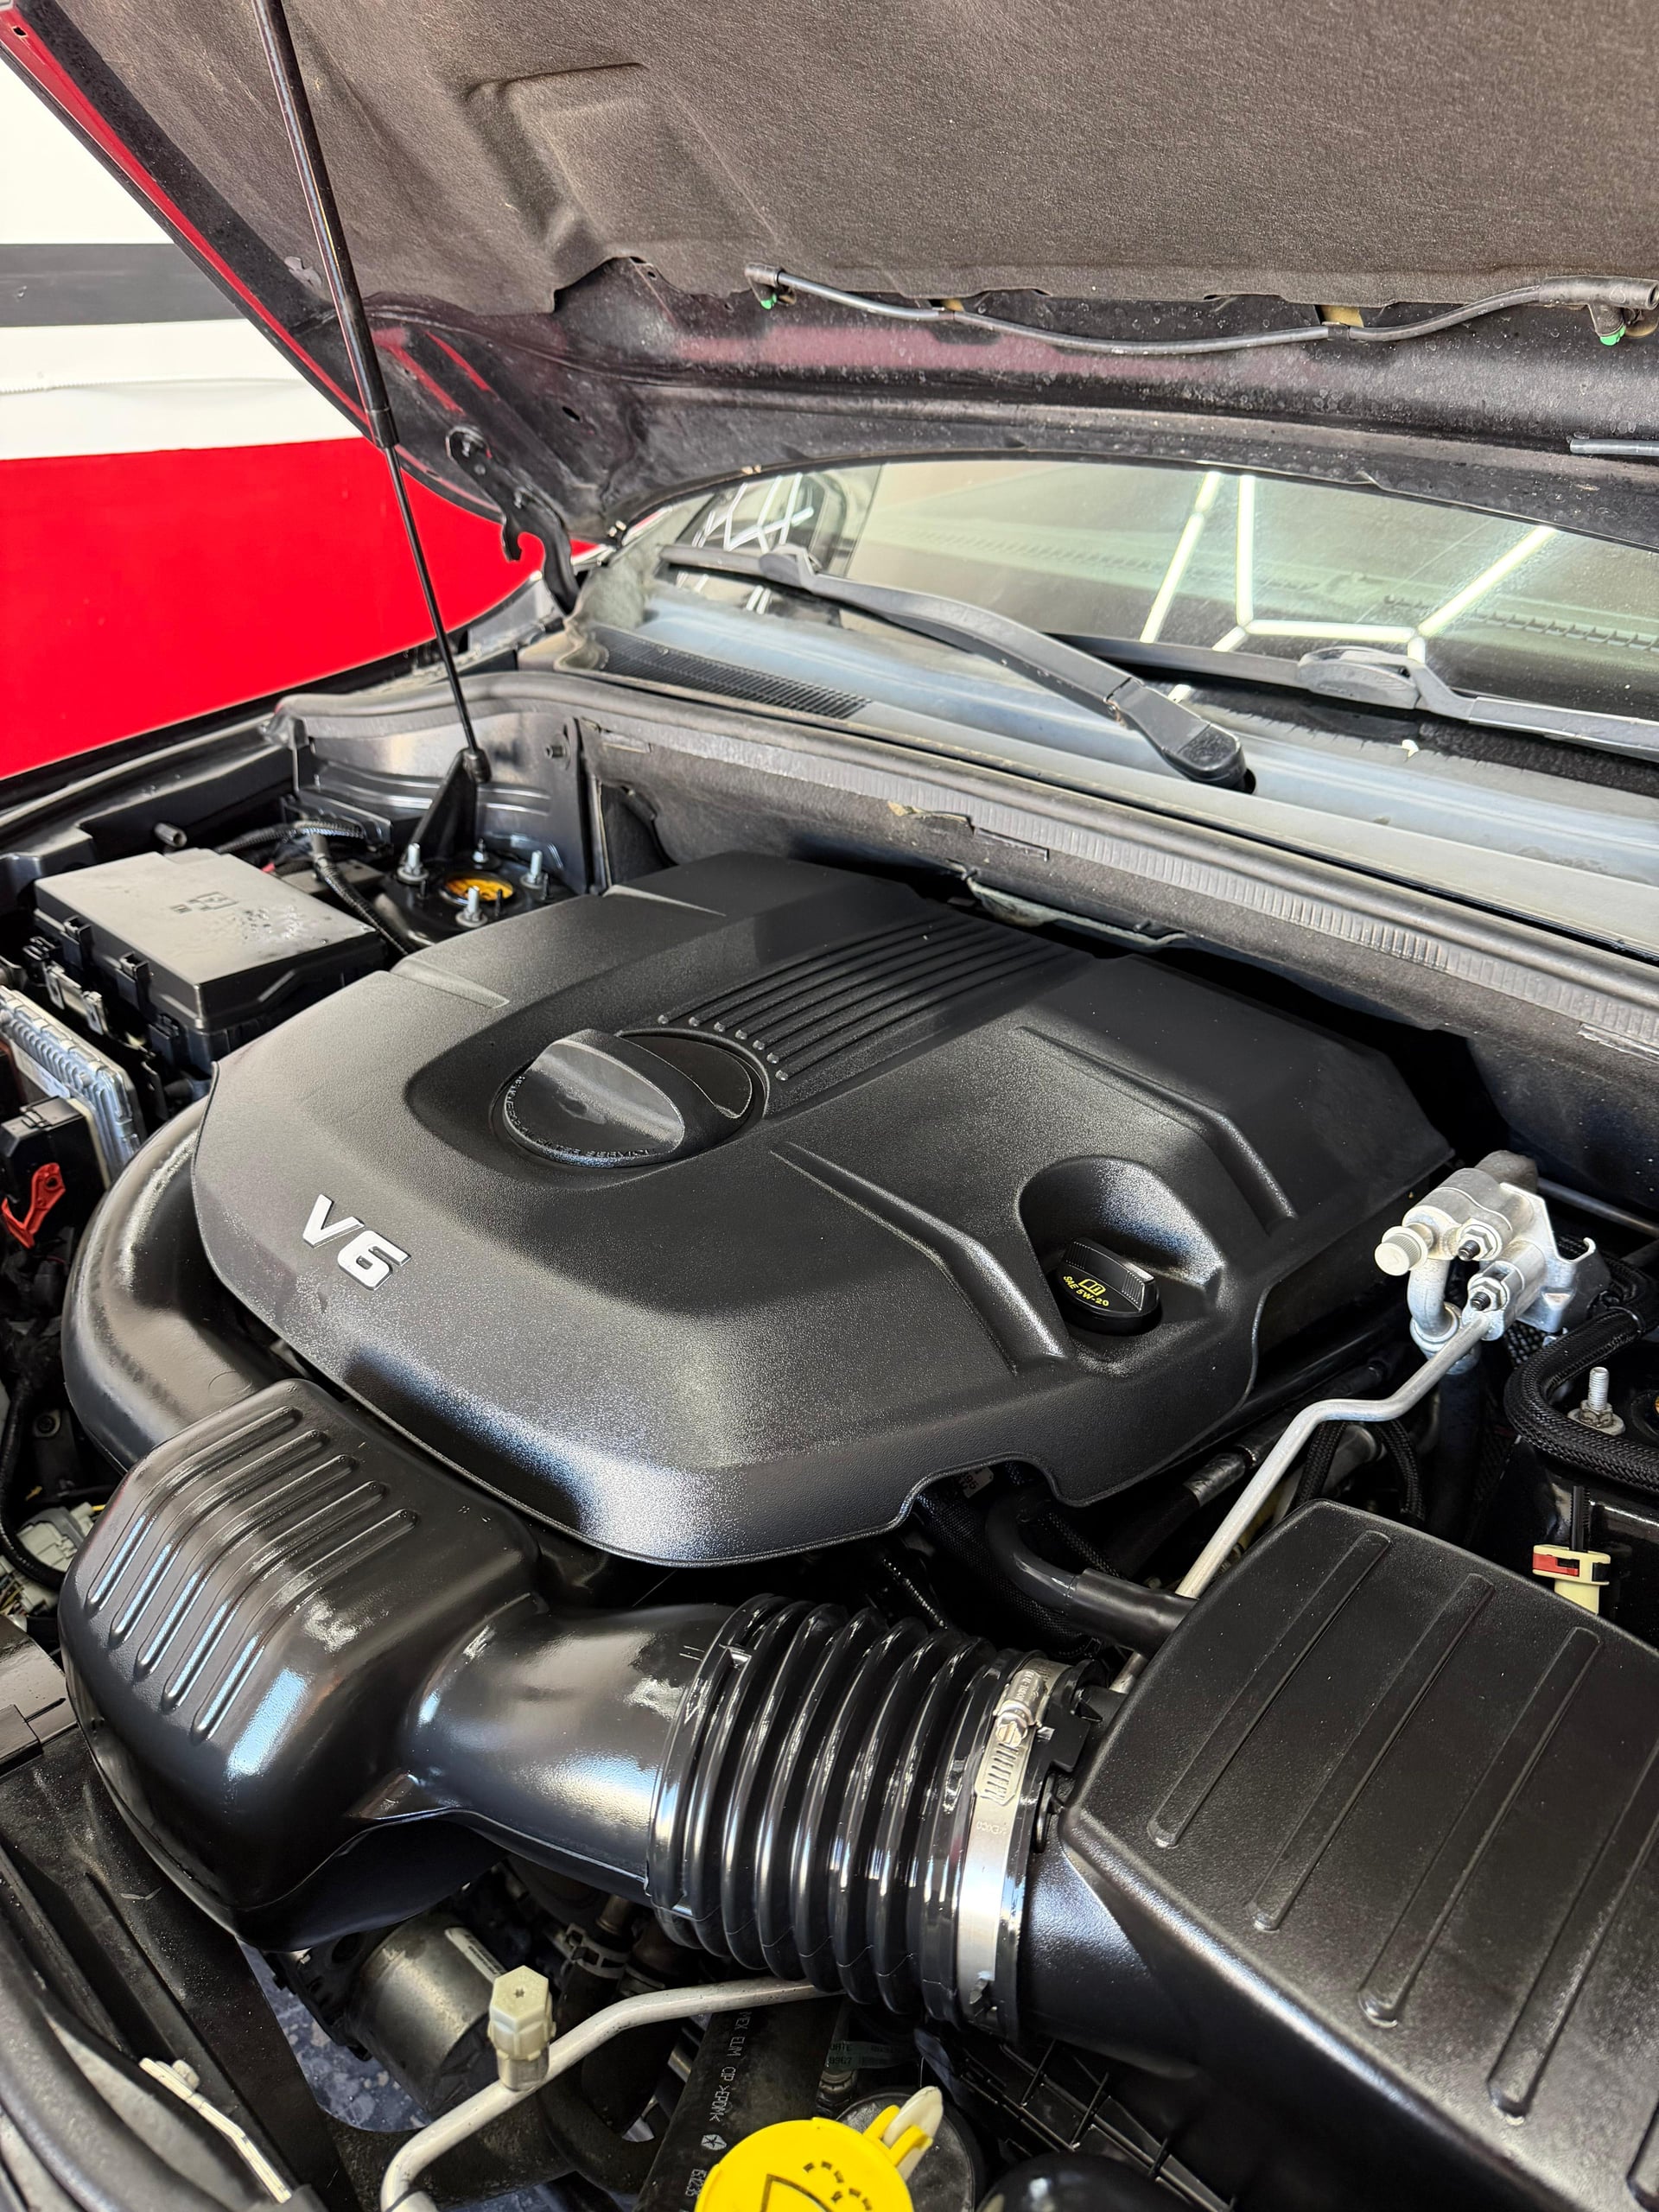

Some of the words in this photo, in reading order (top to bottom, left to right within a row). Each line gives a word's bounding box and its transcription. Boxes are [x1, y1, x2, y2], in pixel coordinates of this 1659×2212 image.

[302, 1193, 411, 1291] V6
[1063, 1275, 1079, 1290] SAE
[1076, 1288, 1109, 1306] 5W-20
[727, 2036, 745, 2056] ELM
